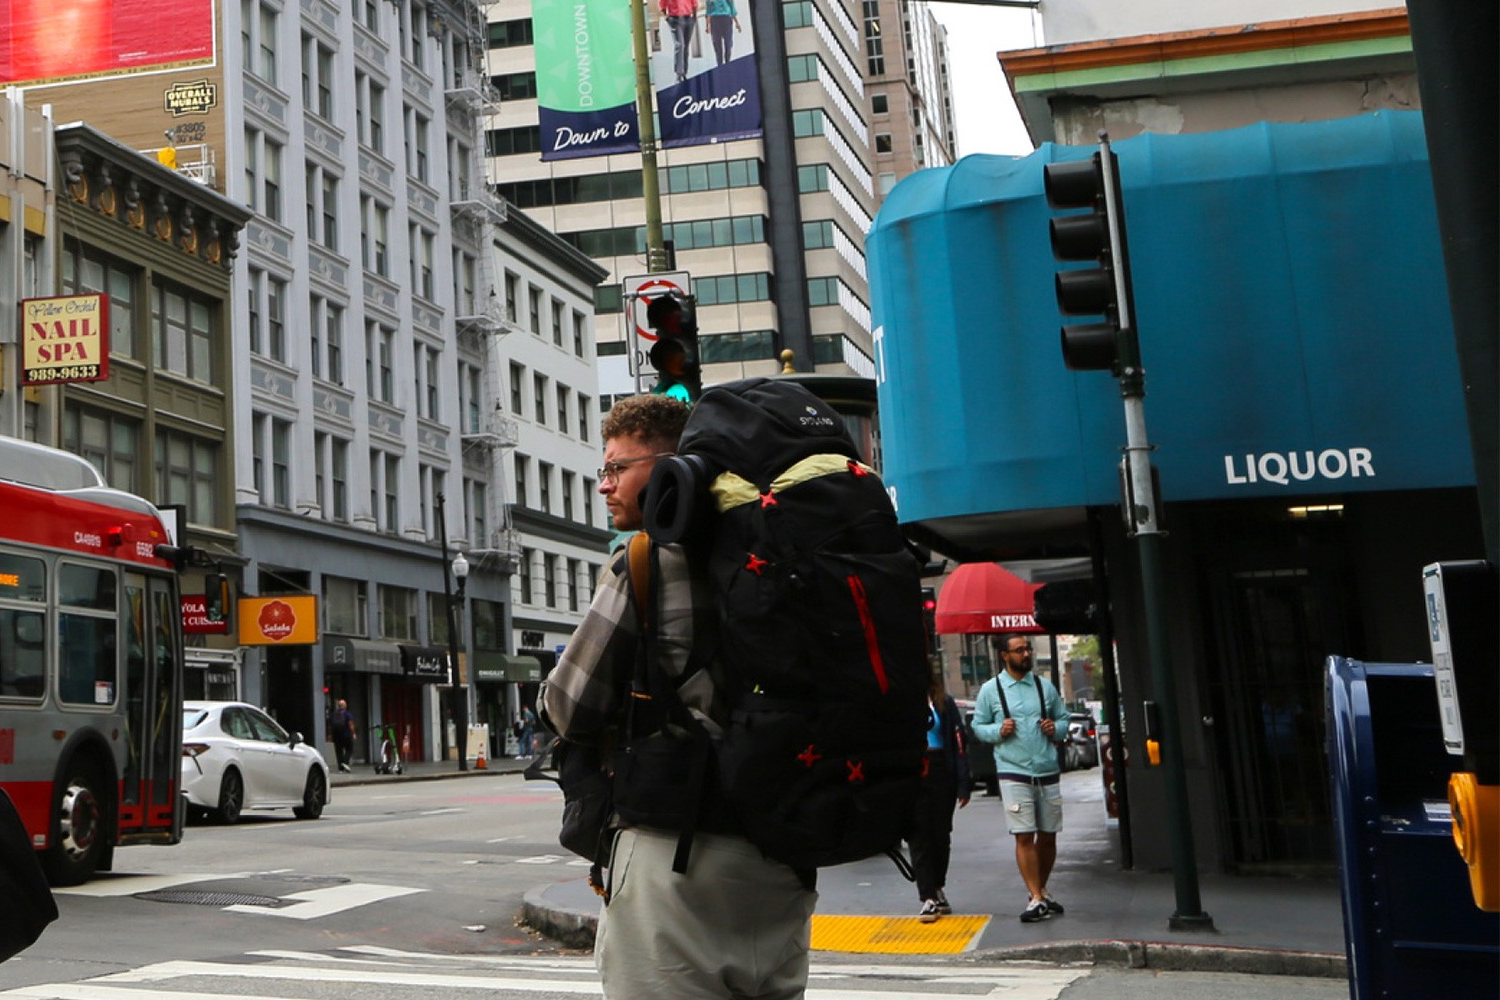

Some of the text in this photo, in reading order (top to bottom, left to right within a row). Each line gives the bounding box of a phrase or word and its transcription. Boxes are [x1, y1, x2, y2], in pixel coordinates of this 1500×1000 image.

[572, 3, 594, 108] DOWNTOWN
[168, 88, 212, 100] OVERALL
[170, 96, 211, 108] MURALS
[673, 88, 747, 119] Connect
[553, 120, 630, 152] Down to
[29, 318, 97, 342] NAIL
[37, 341, 89, 364] SPA
[28, 365, 98, 381] 989-9633
[1224, 447, 1376, 486] LIQUOR
